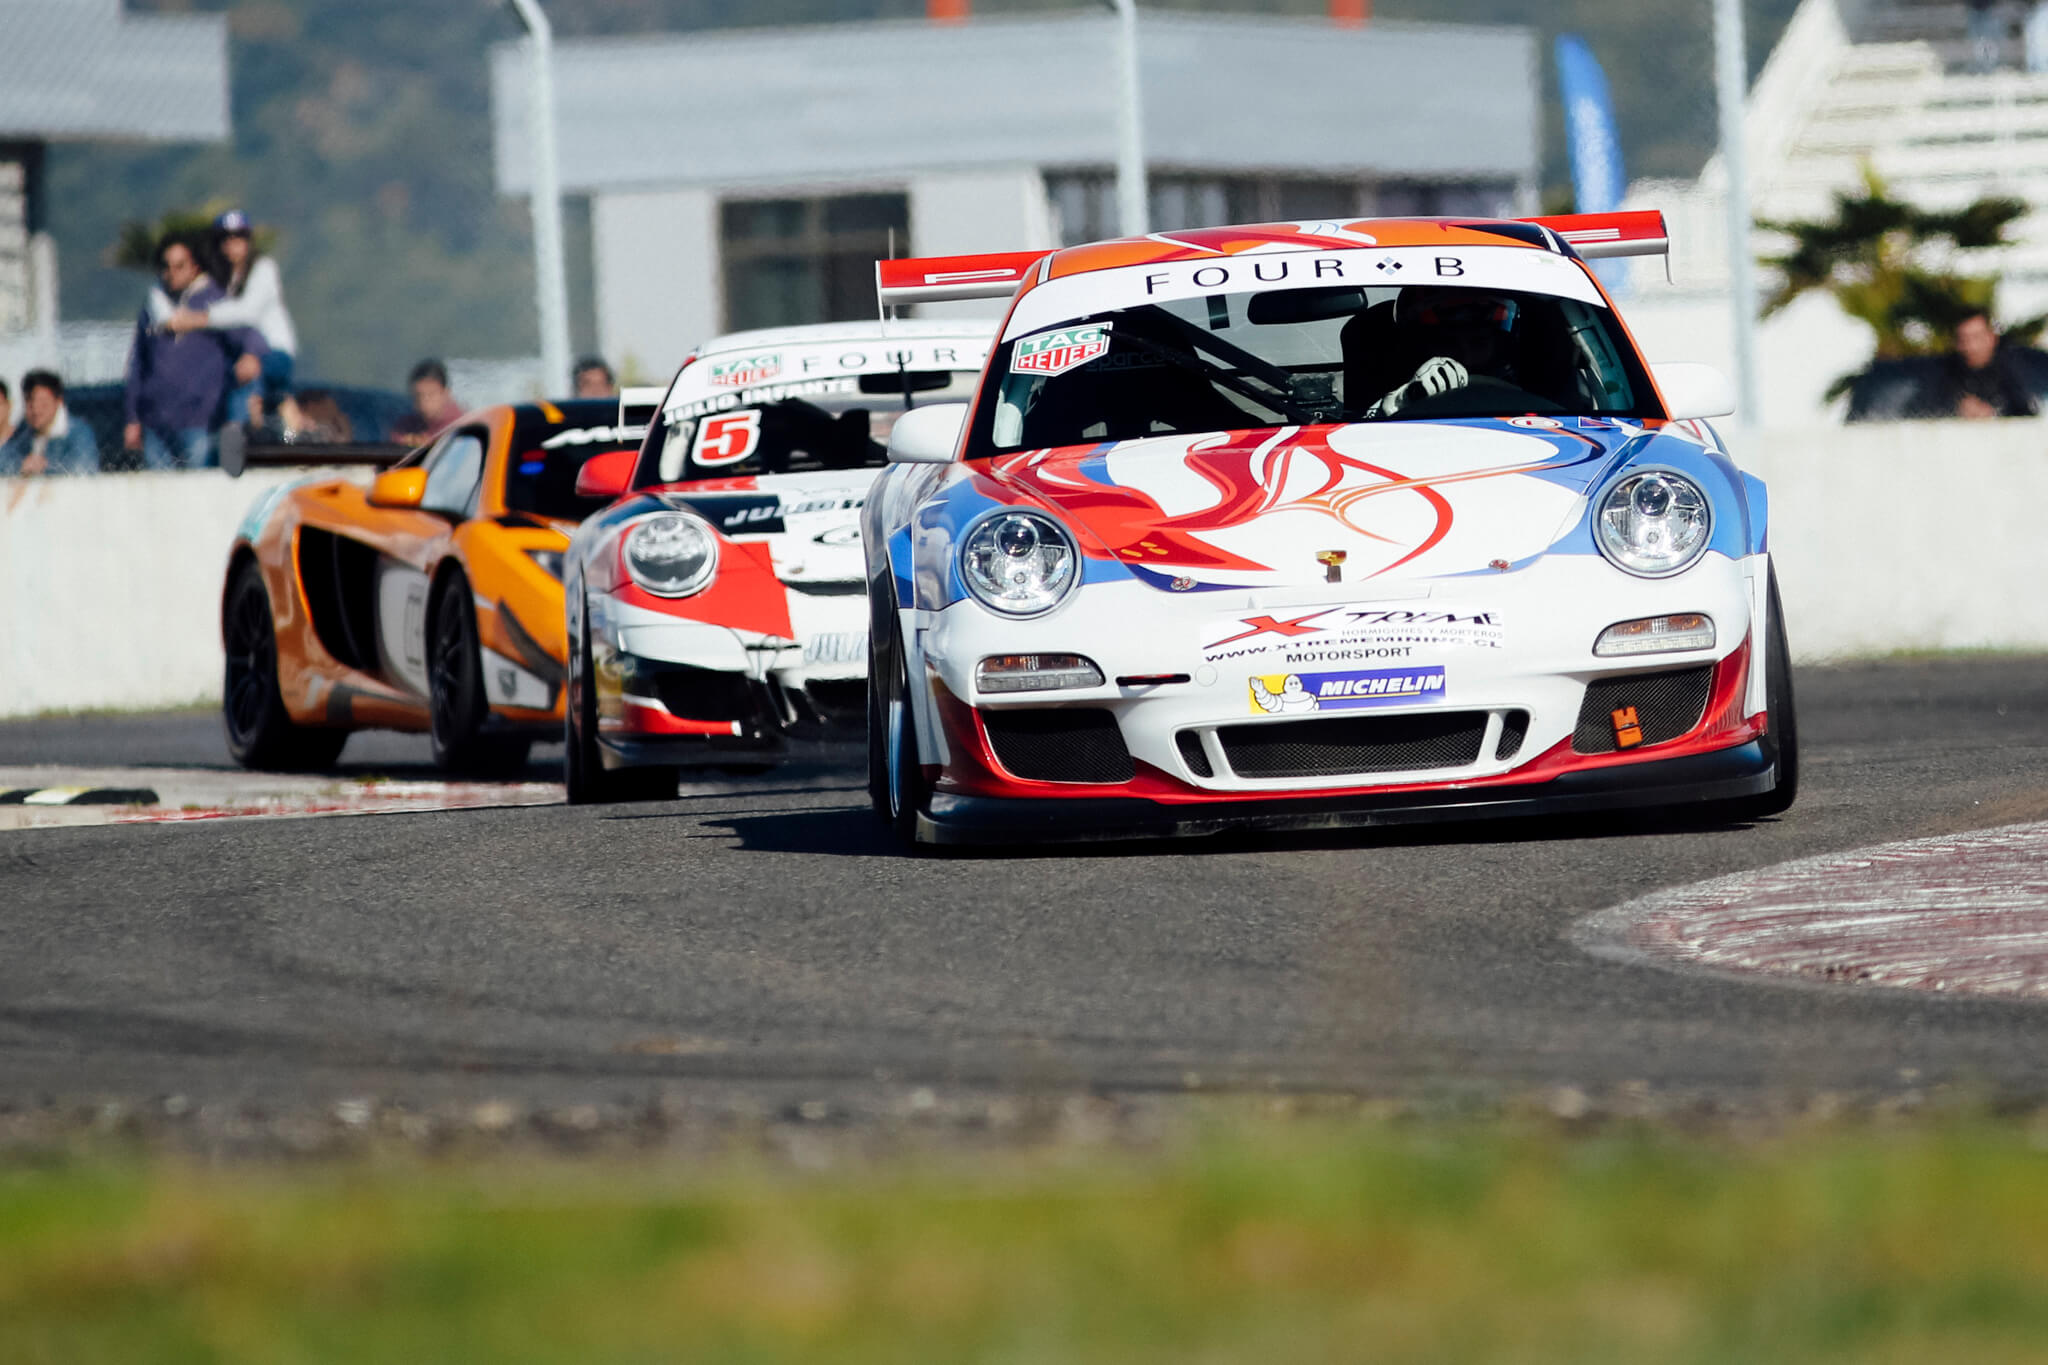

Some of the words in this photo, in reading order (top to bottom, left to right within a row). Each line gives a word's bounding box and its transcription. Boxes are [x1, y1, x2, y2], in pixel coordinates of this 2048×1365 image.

[1145, 258, 1344, 295] FOUR
[1434, 256, 1465, 278] B
[1024, 328, 1100, 354] TAG
[714, 355, 778, 375] TAG
[802, 348, 957, 373] FOUR
[1018, 342, 1102, 370] HEUER
[662, 392, 738, 426] JULIO
[699, 415, 752, 462] 5
[1341, 626, 1423, 637] HORMIGONES
[1439, 628, 1504, 640] MORTEROS
[1285, 647, 1414, 663] MOTORSPORT
[1318, 673, 1445, 697] MICHELIN
